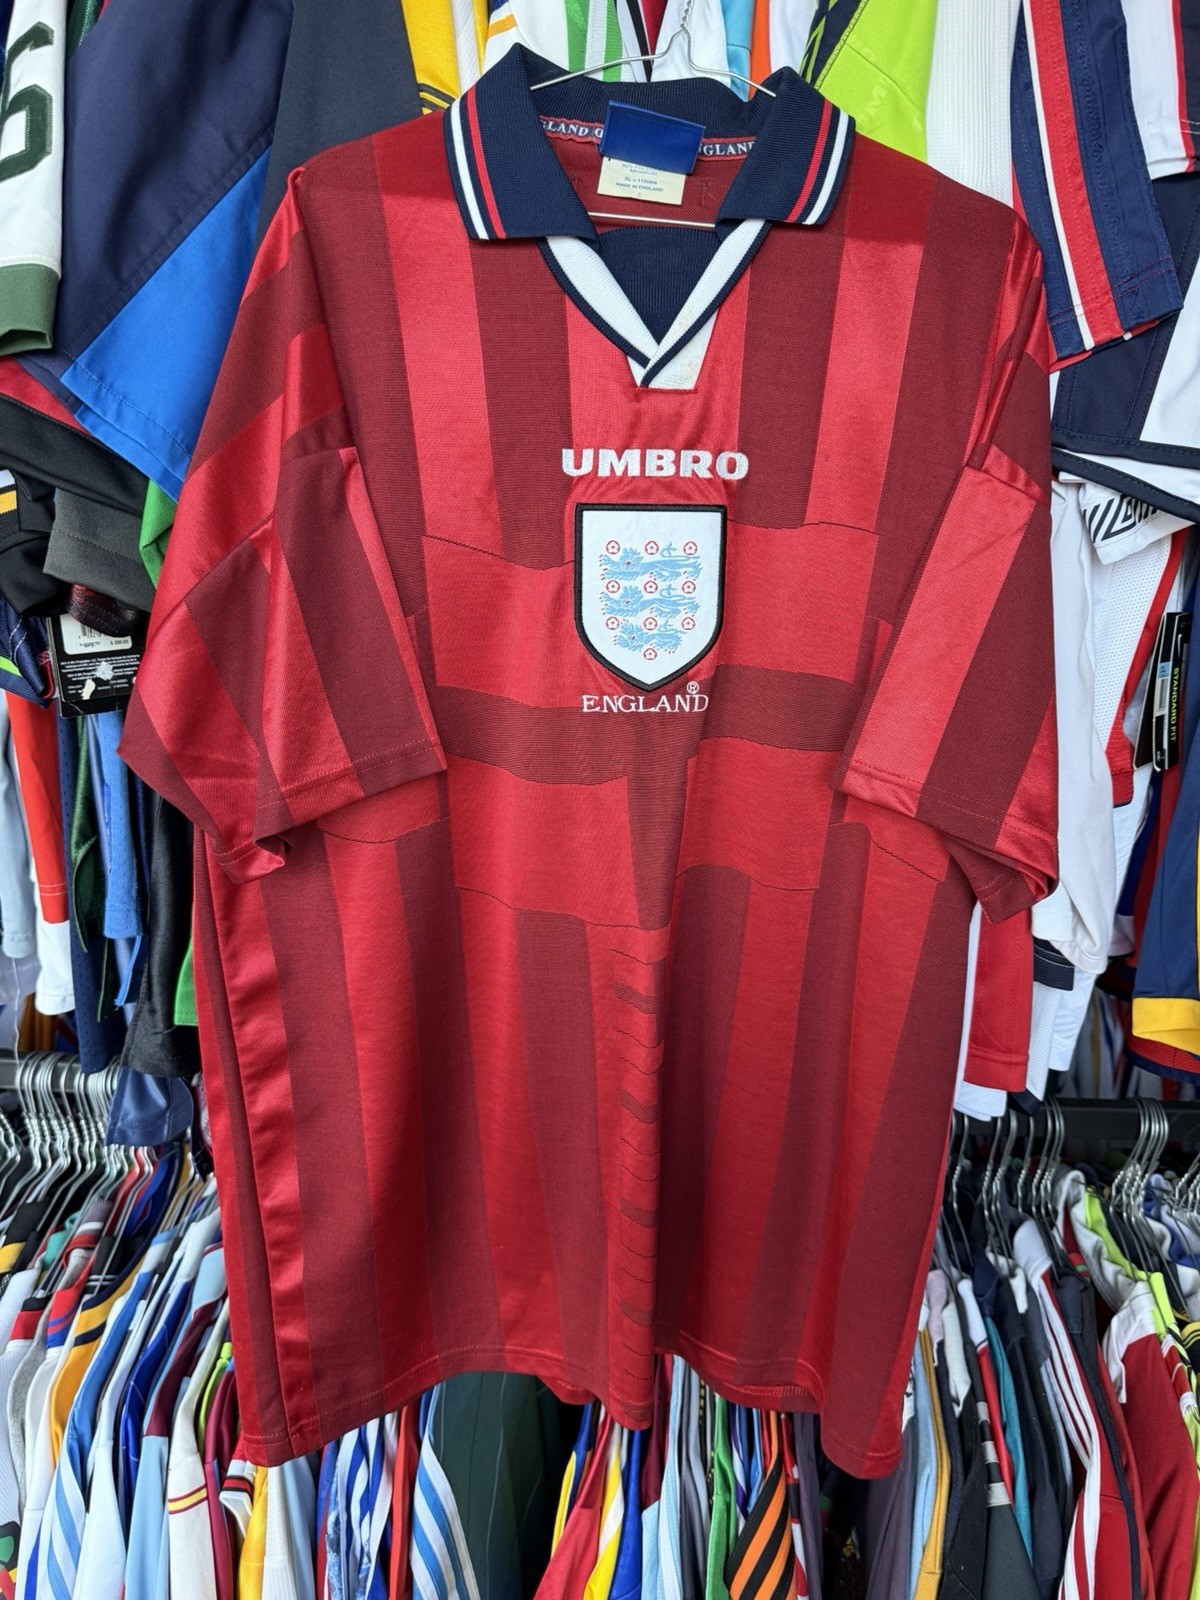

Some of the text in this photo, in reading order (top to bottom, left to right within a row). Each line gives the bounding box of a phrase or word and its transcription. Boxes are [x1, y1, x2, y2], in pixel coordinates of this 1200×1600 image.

[561, 448, 750, 481] UMBRO
[582, 694, 709, 713] ENGLAND
[1170, 667, 1180, 724] STANDARD
